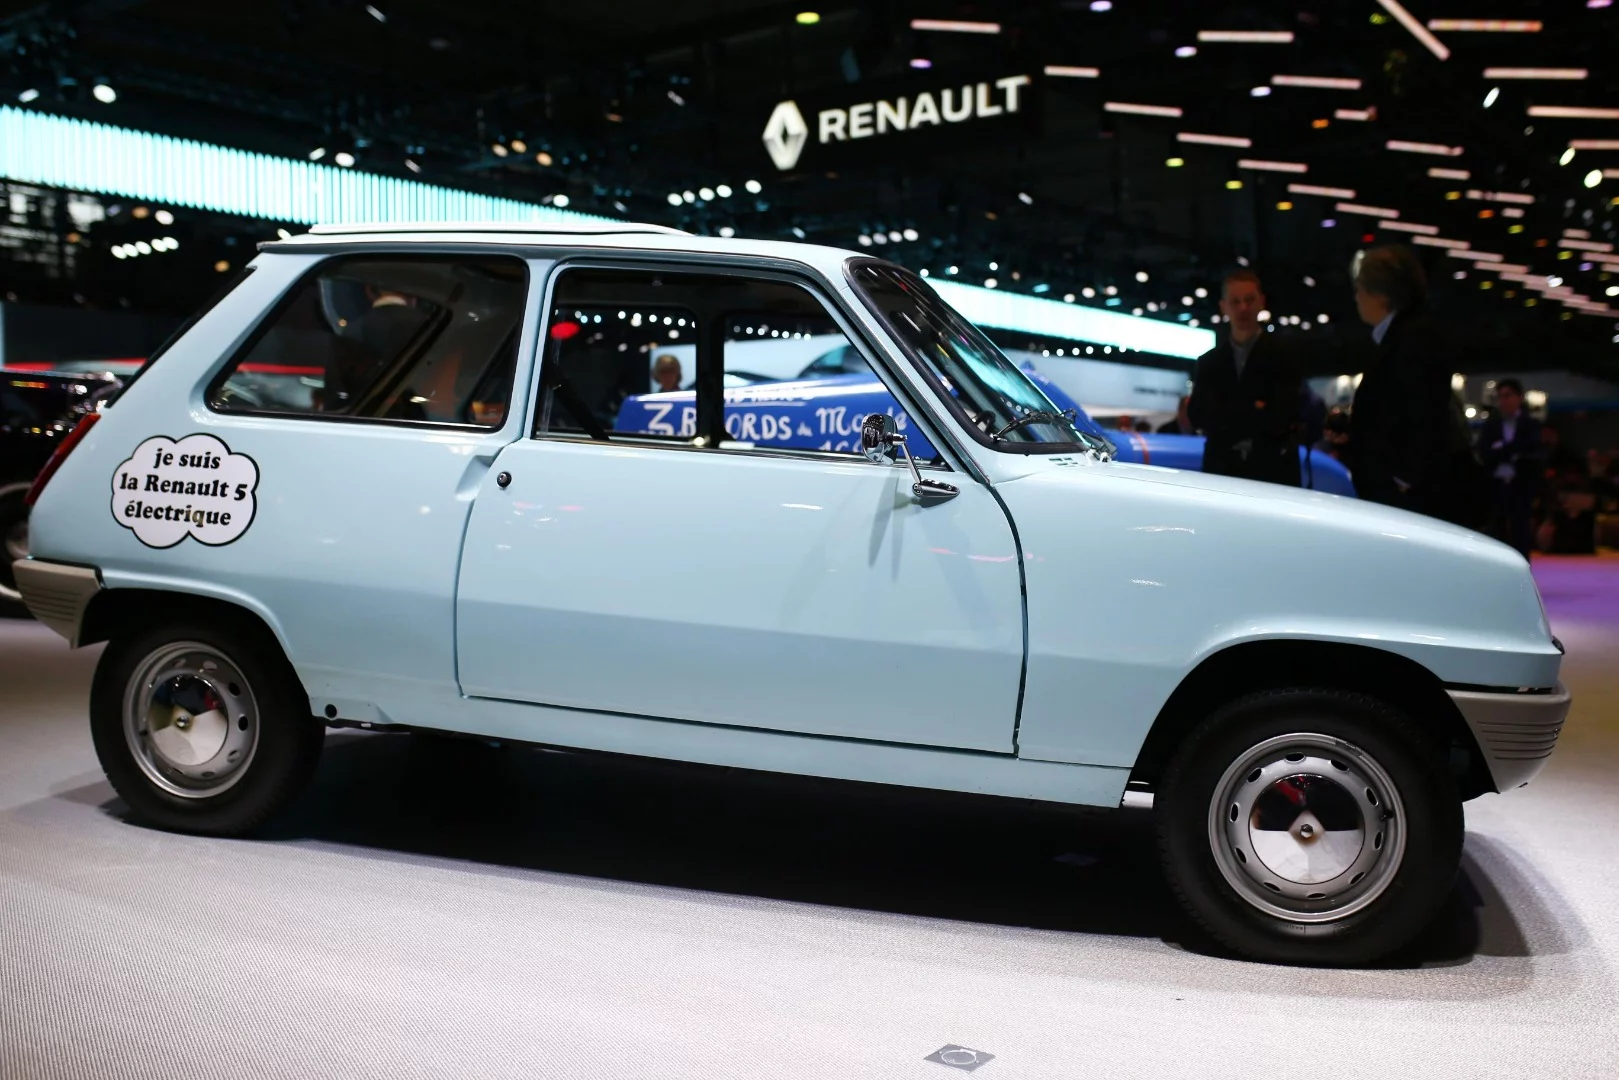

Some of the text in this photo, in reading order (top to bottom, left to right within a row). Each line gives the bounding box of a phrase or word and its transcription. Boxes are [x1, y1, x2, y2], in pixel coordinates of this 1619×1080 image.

[818, 75, 1030, 143] RENAULT
[681, 407, 793, 440] RORDS
[153, 447, 221, 469] je suis
[119, 473, 248, 501] la Renault 5
[124, 500, 231, 528] électrique
